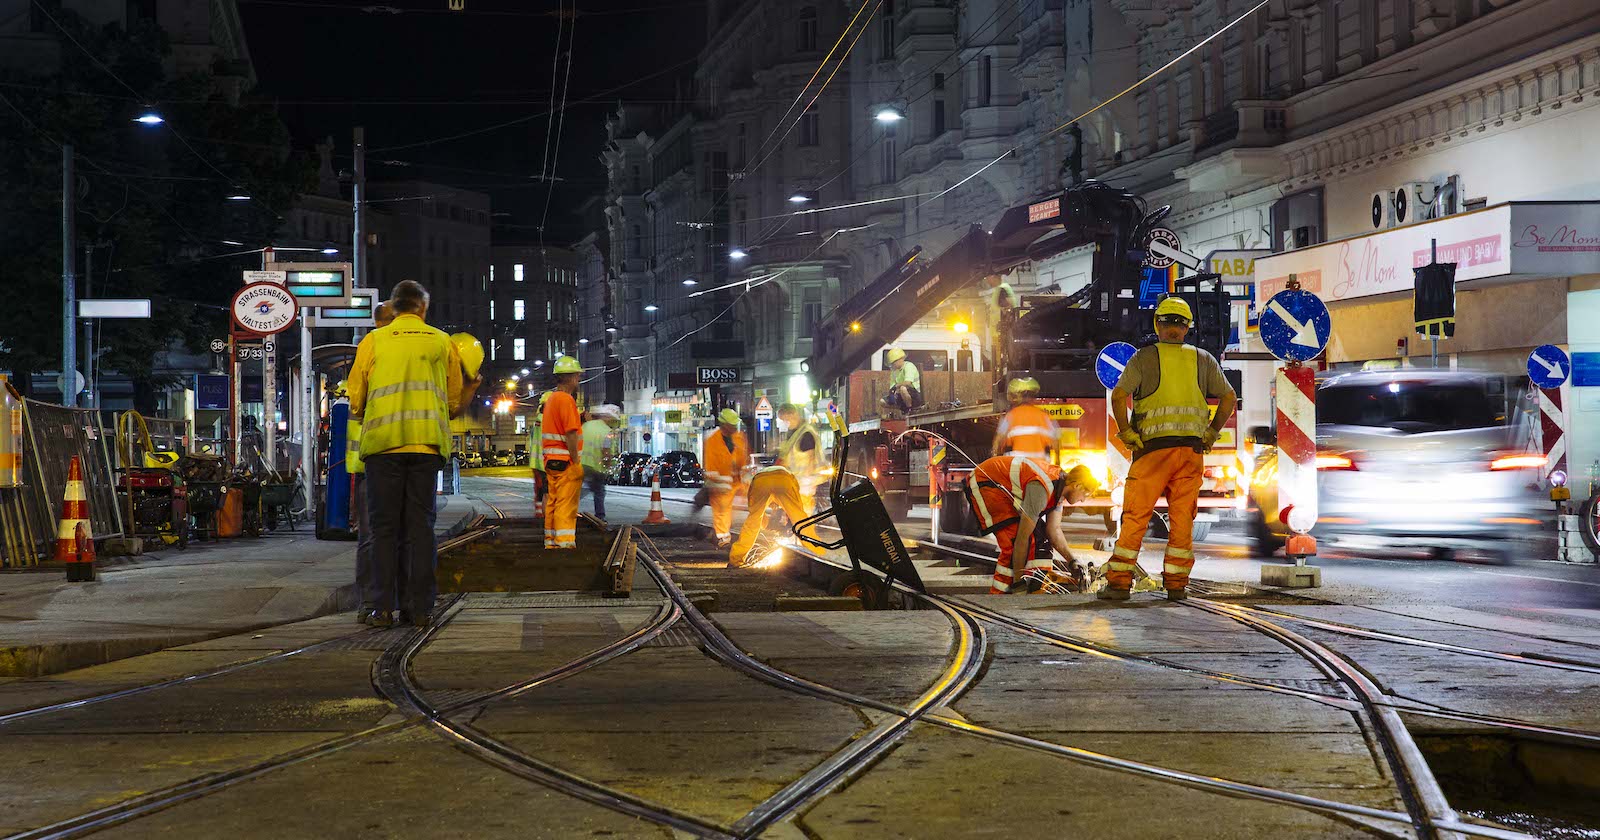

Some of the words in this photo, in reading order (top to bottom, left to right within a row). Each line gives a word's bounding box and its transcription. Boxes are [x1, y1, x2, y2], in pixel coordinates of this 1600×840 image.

[1513, 225, 1545, 248] Be
[1474, 241, 1496, 259] BABY
[238, 289, 290, 306] STRASSENBAHN
[242, 313, 288, 329] HALTESTLE
[212, 342, 223, 350] 38
[265, 343, 273, 352] 5
[239, 349, 249, 358] 37
[252, 349, 263, 358] 33
[702, 368, 737, 379] BOSS
[1065, 408, 1081, 416] aus
[880, 528, 901, 564] WIEBAU
